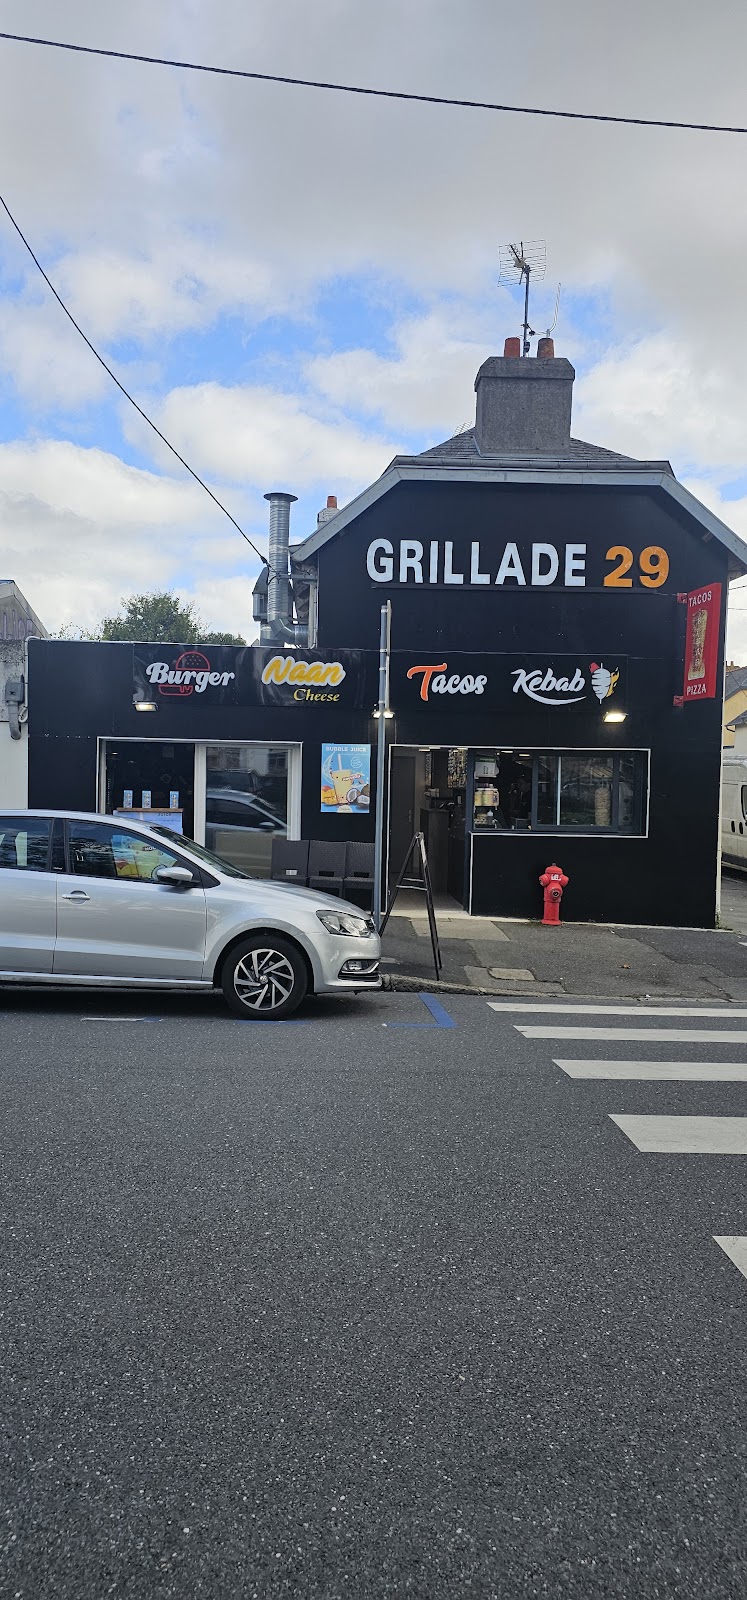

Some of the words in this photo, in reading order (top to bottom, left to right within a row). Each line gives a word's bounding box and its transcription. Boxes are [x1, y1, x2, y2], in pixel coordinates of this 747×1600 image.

[366, 538, 587, 586] GRILLADE
[603, 545, 670, 588] 29
[688, 590, 712, 607] TACOS
[145, 662, 235, 693] Burger
[262, 656, 346, 687] Naan
[406, 662, 488, 702] Tacos
[510, 667, 587, 705] Kebab
[293, 688, 340, 702] Cheese
[686, 683, 707, 696] PIZZA
